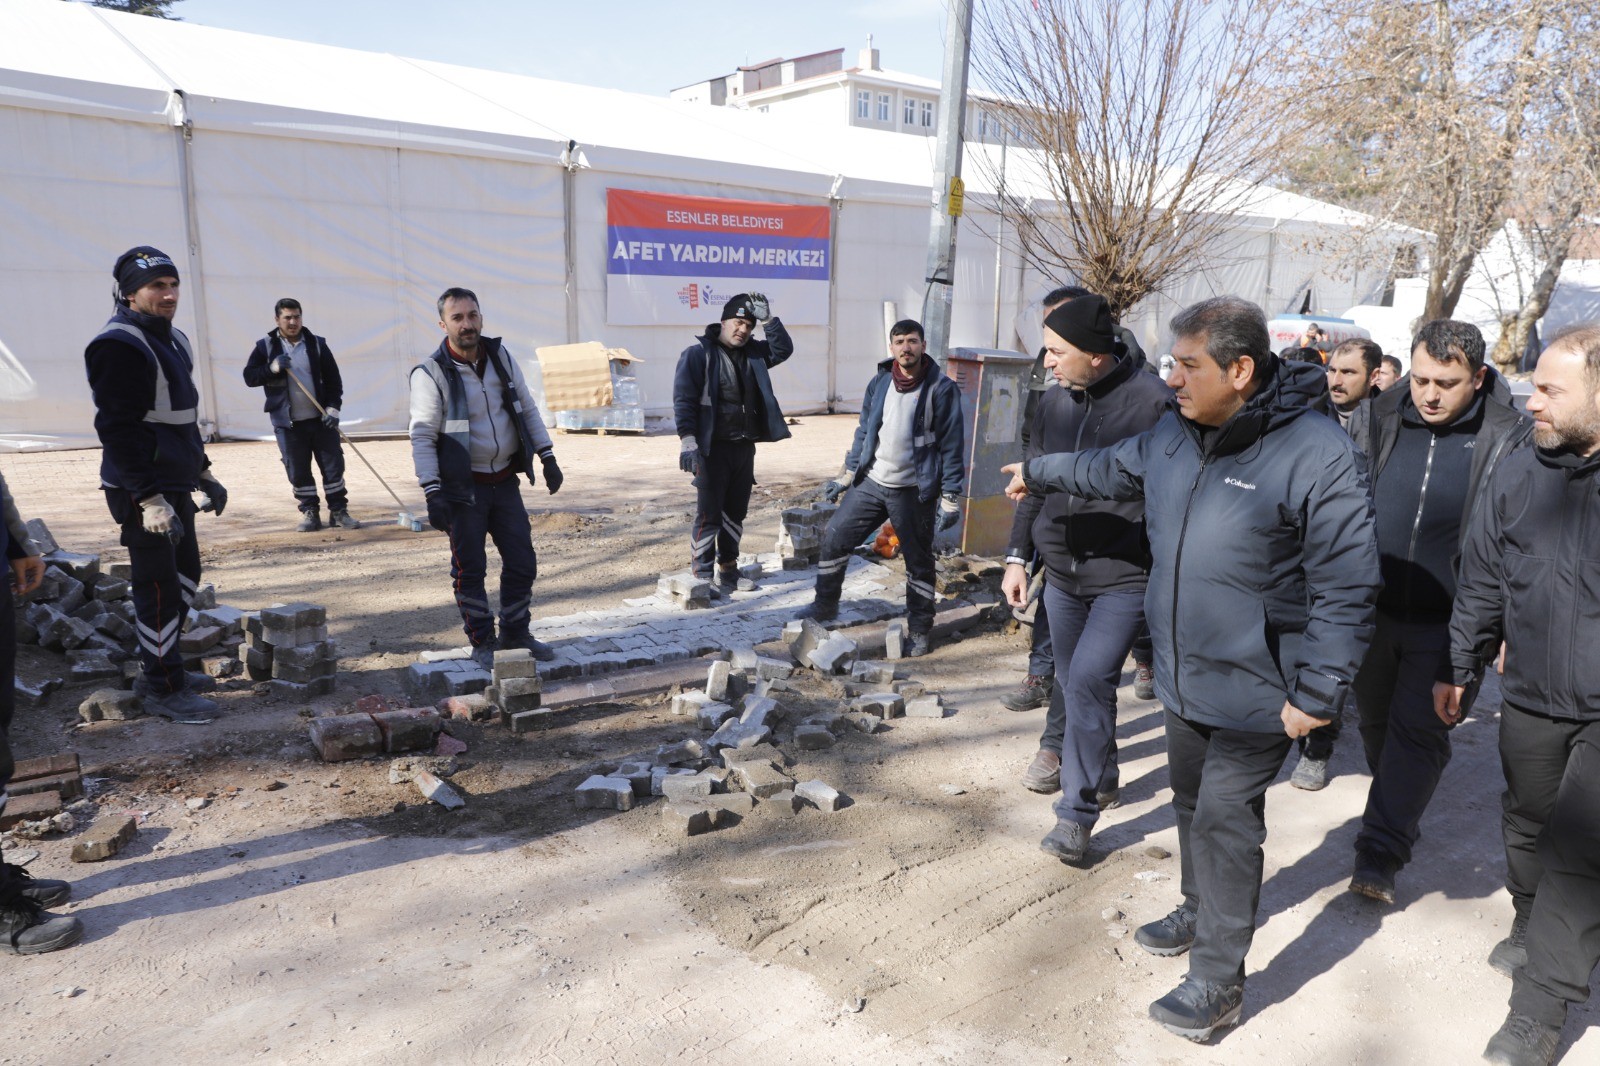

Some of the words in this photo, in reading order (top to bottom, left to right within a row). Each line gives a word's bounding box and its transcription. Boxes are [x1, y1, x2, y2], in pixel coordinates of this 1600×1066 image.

[666, 210, 719, 226] ESENLER
[722, 215, 783, 230] BELEDİYESİ
[612, 240, 665, 261] AFET
[669, 243, 745, 264] YARDIM
[749, 247, 825, 268] MERKEZİ
